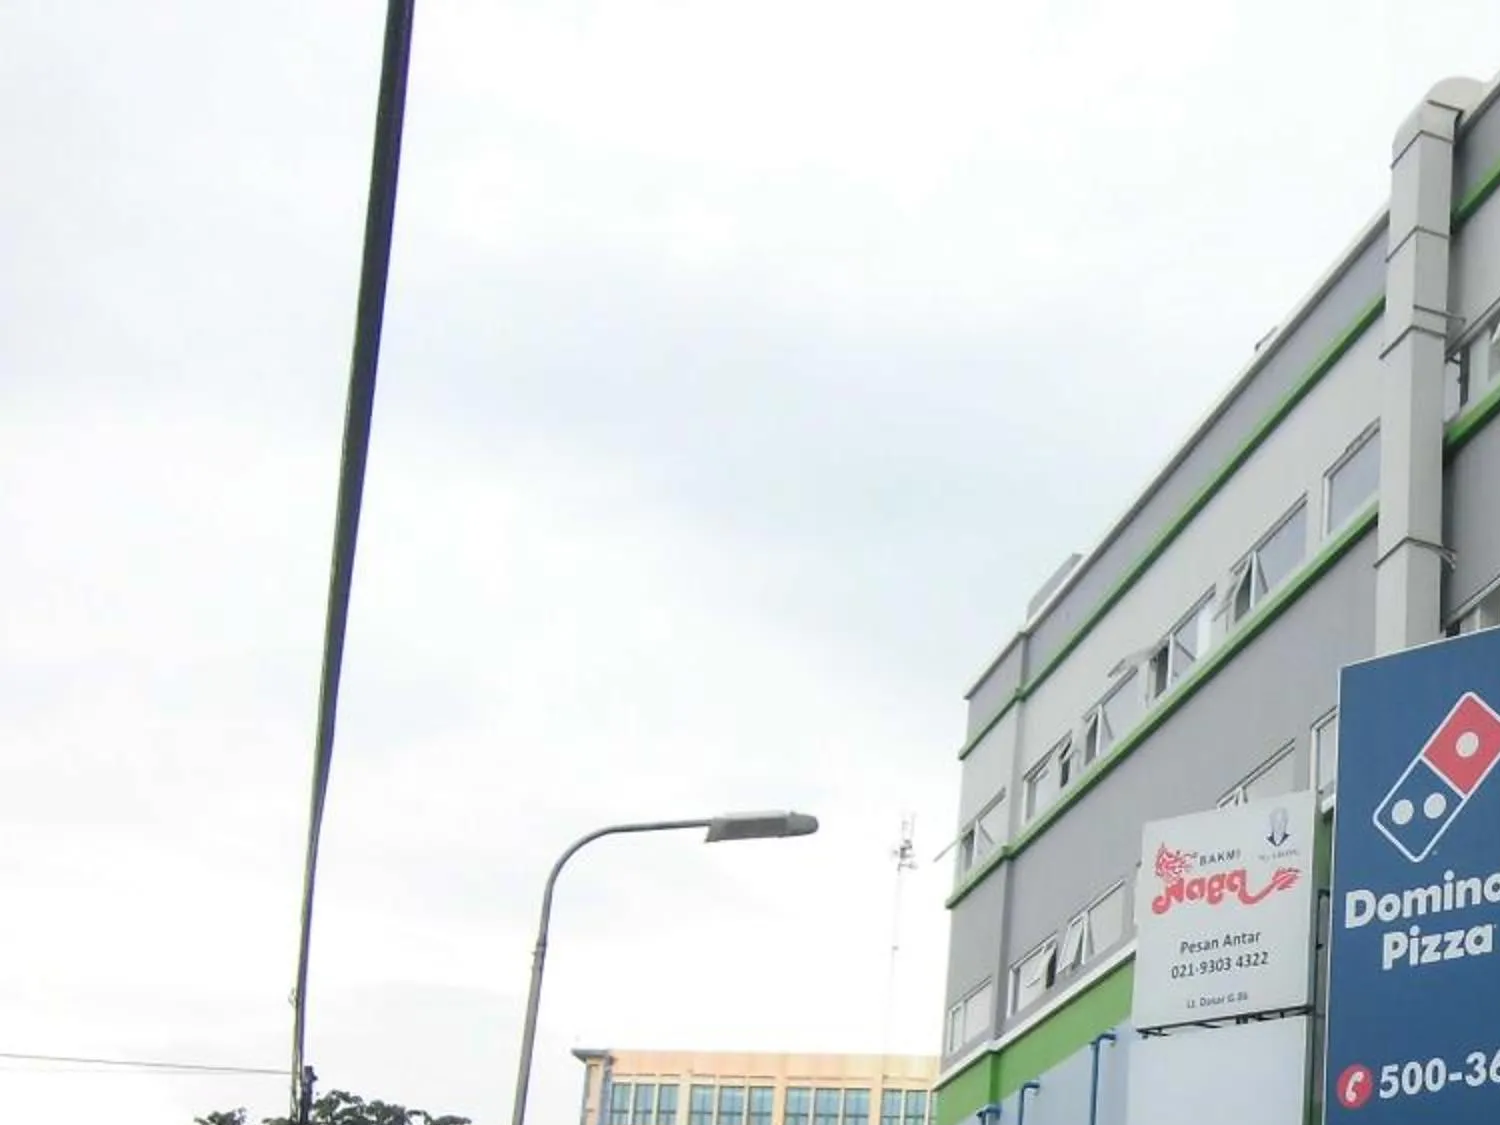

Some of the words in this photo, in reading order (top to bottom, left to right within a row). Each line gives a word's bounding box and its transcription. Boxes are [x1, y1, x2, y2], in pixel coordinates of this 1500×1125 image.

[1200, 849, 1241, 866] BAKMI
[1180, 939, 1219, 954] Pesan
[1222, 932, 1262, 948] Antar
[1382, 924, 1494, 970] Pizza
[1171, 957, 1232, 979] 021-9303
[1235, 951, 1269, 969] 4322
